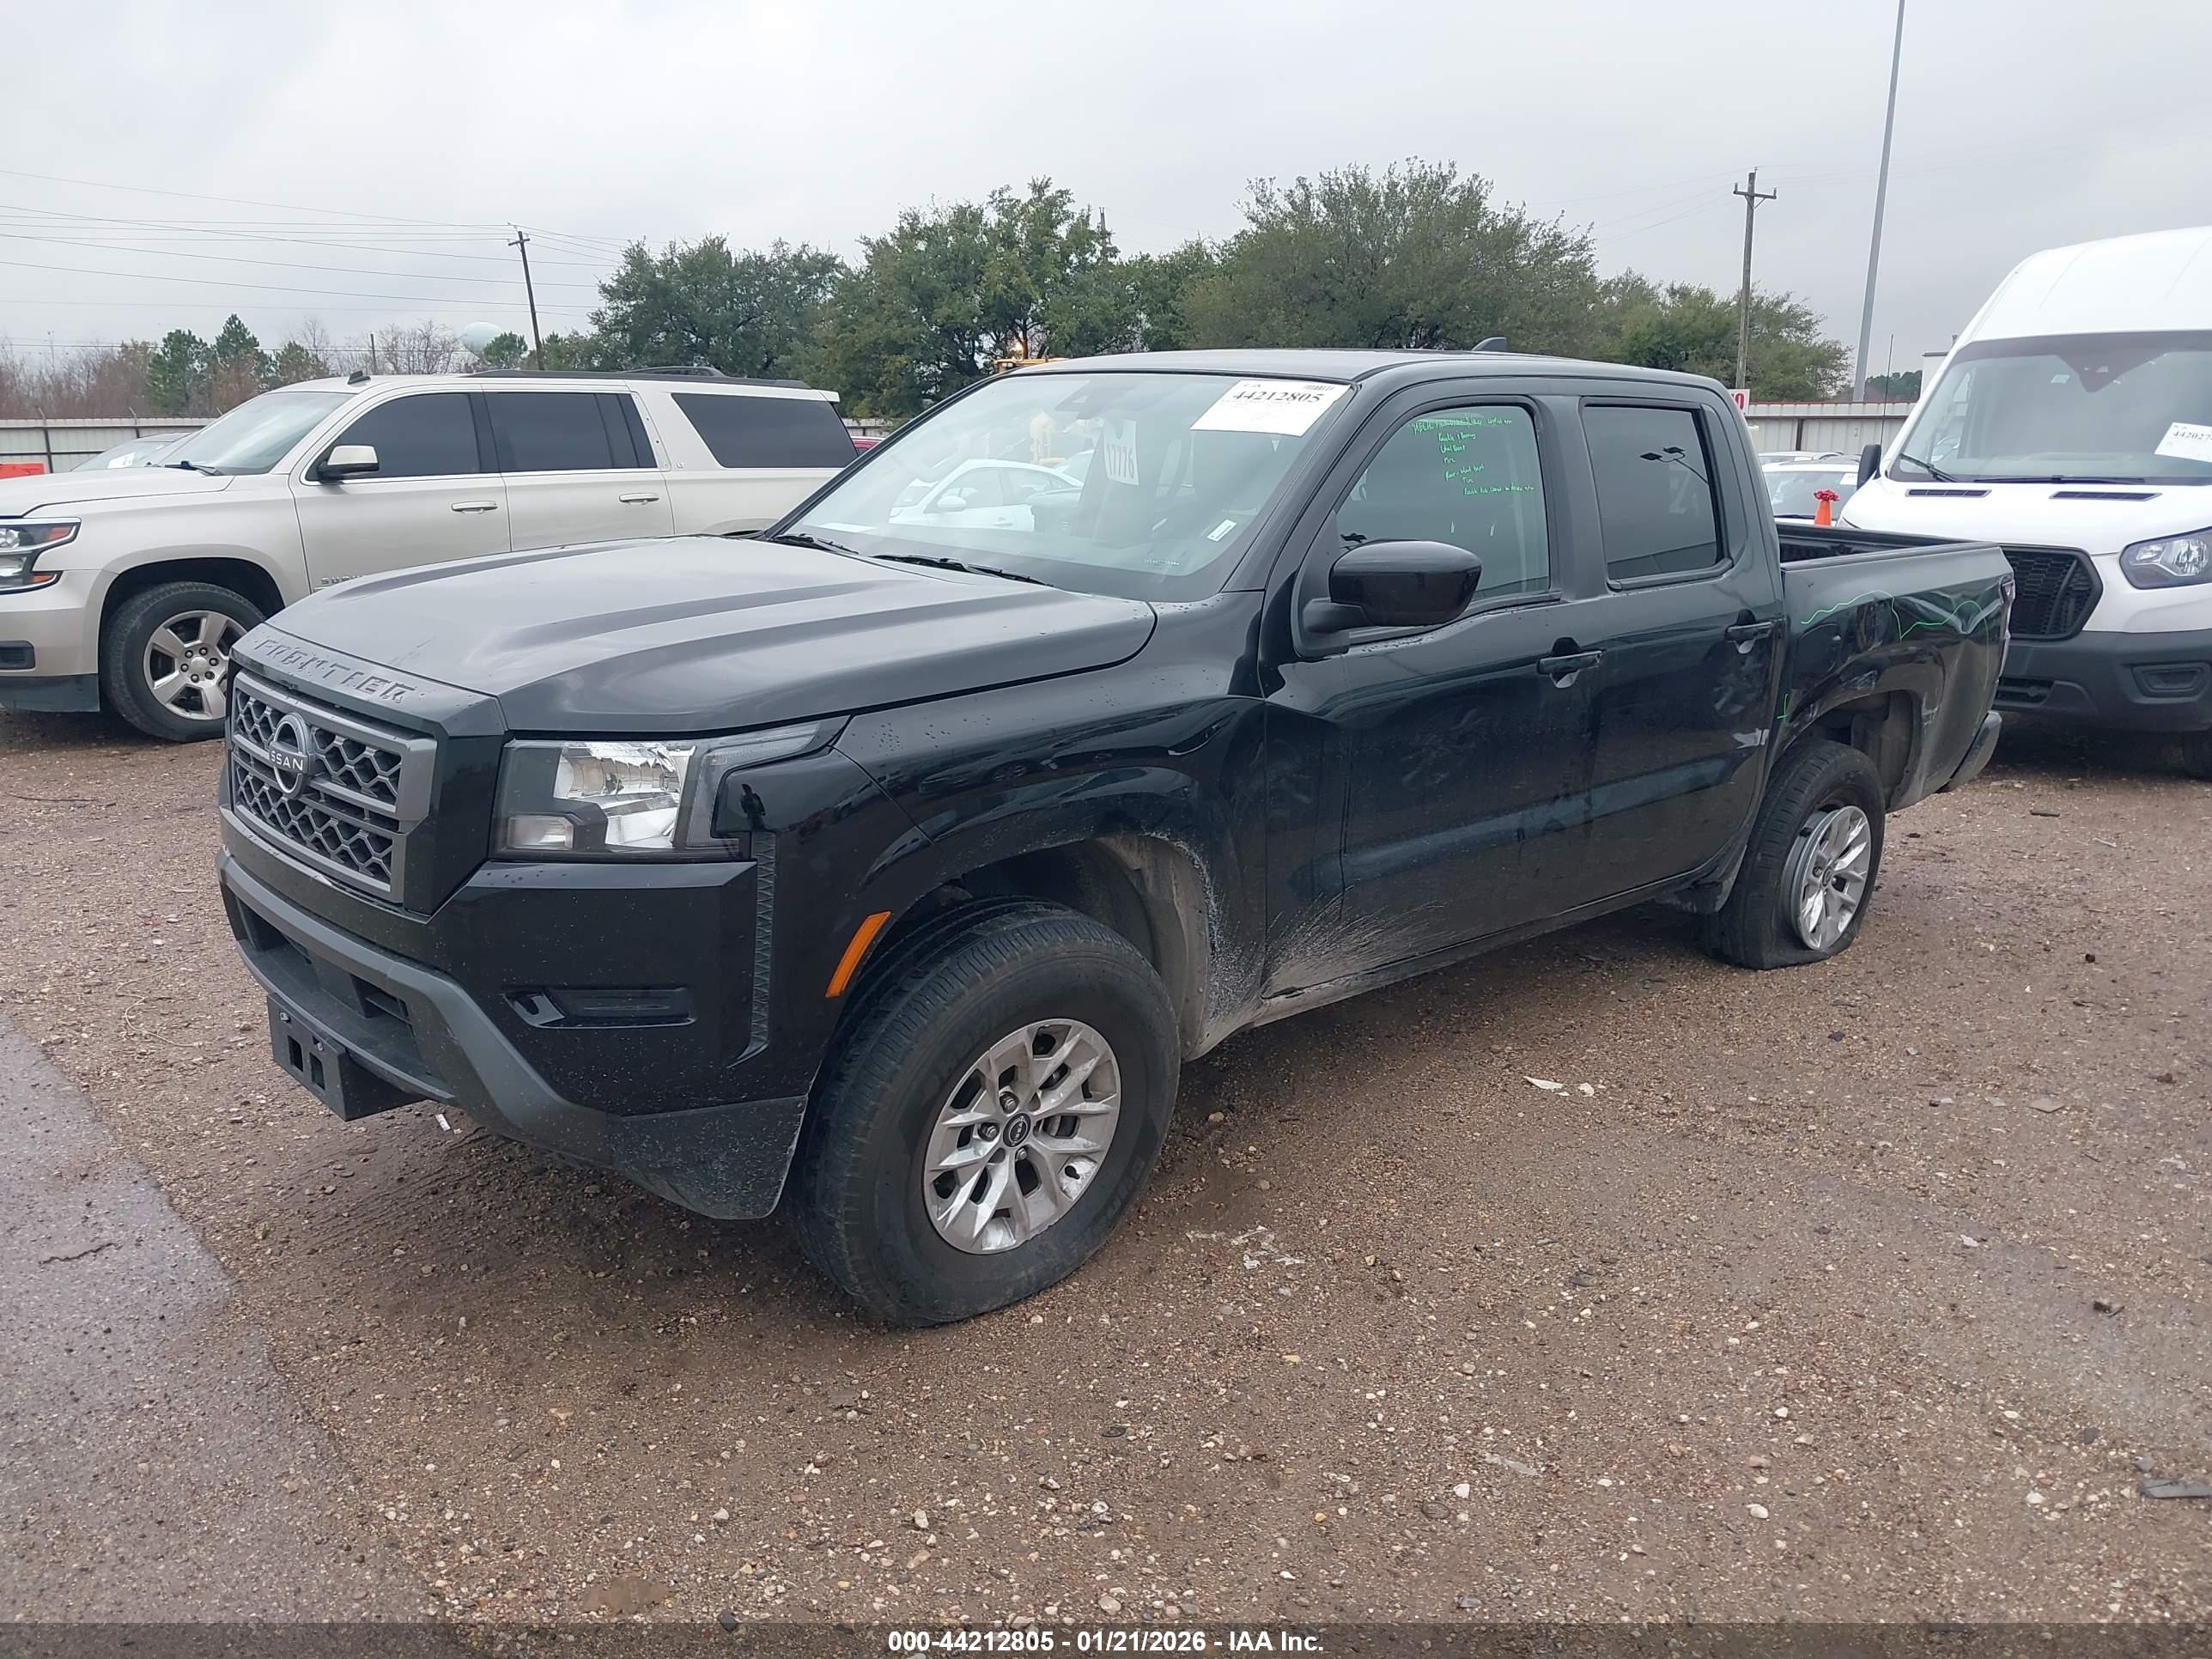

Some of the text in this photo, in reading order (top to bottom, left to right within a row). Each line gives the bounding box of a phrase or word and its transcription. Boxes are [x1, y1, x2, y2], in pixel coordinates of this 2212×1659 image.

[1233, 391, 1324, 403] 44212805
[253, 639, 416, 703] FRONTIER
[270, 750, 303, 771] SSAN
